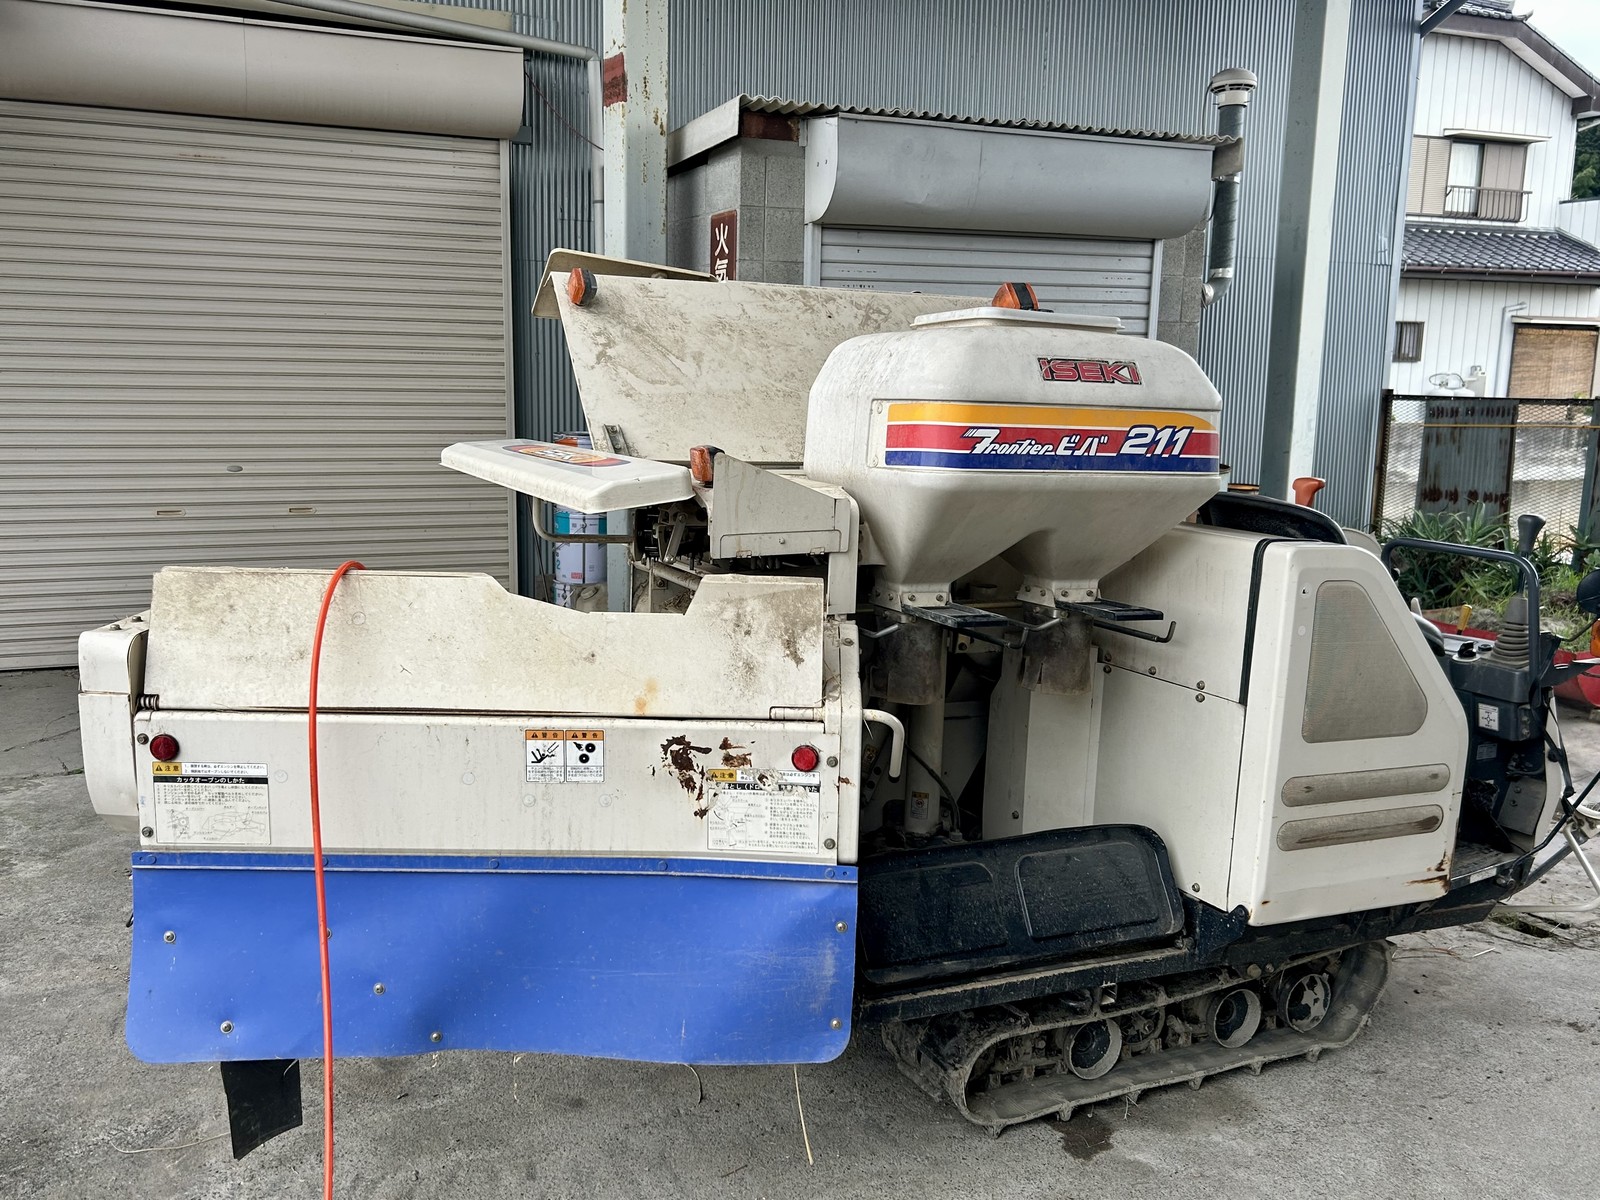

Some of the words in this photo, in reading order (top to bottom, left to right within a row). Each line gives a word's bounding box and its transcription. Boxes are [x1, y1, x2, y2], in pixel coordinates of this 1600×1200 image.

[1037, 357, 1142, 385] ISEKI
[1056, 434, 1109, 457] ビバ
[1119, 425, 1194, 457] 211
